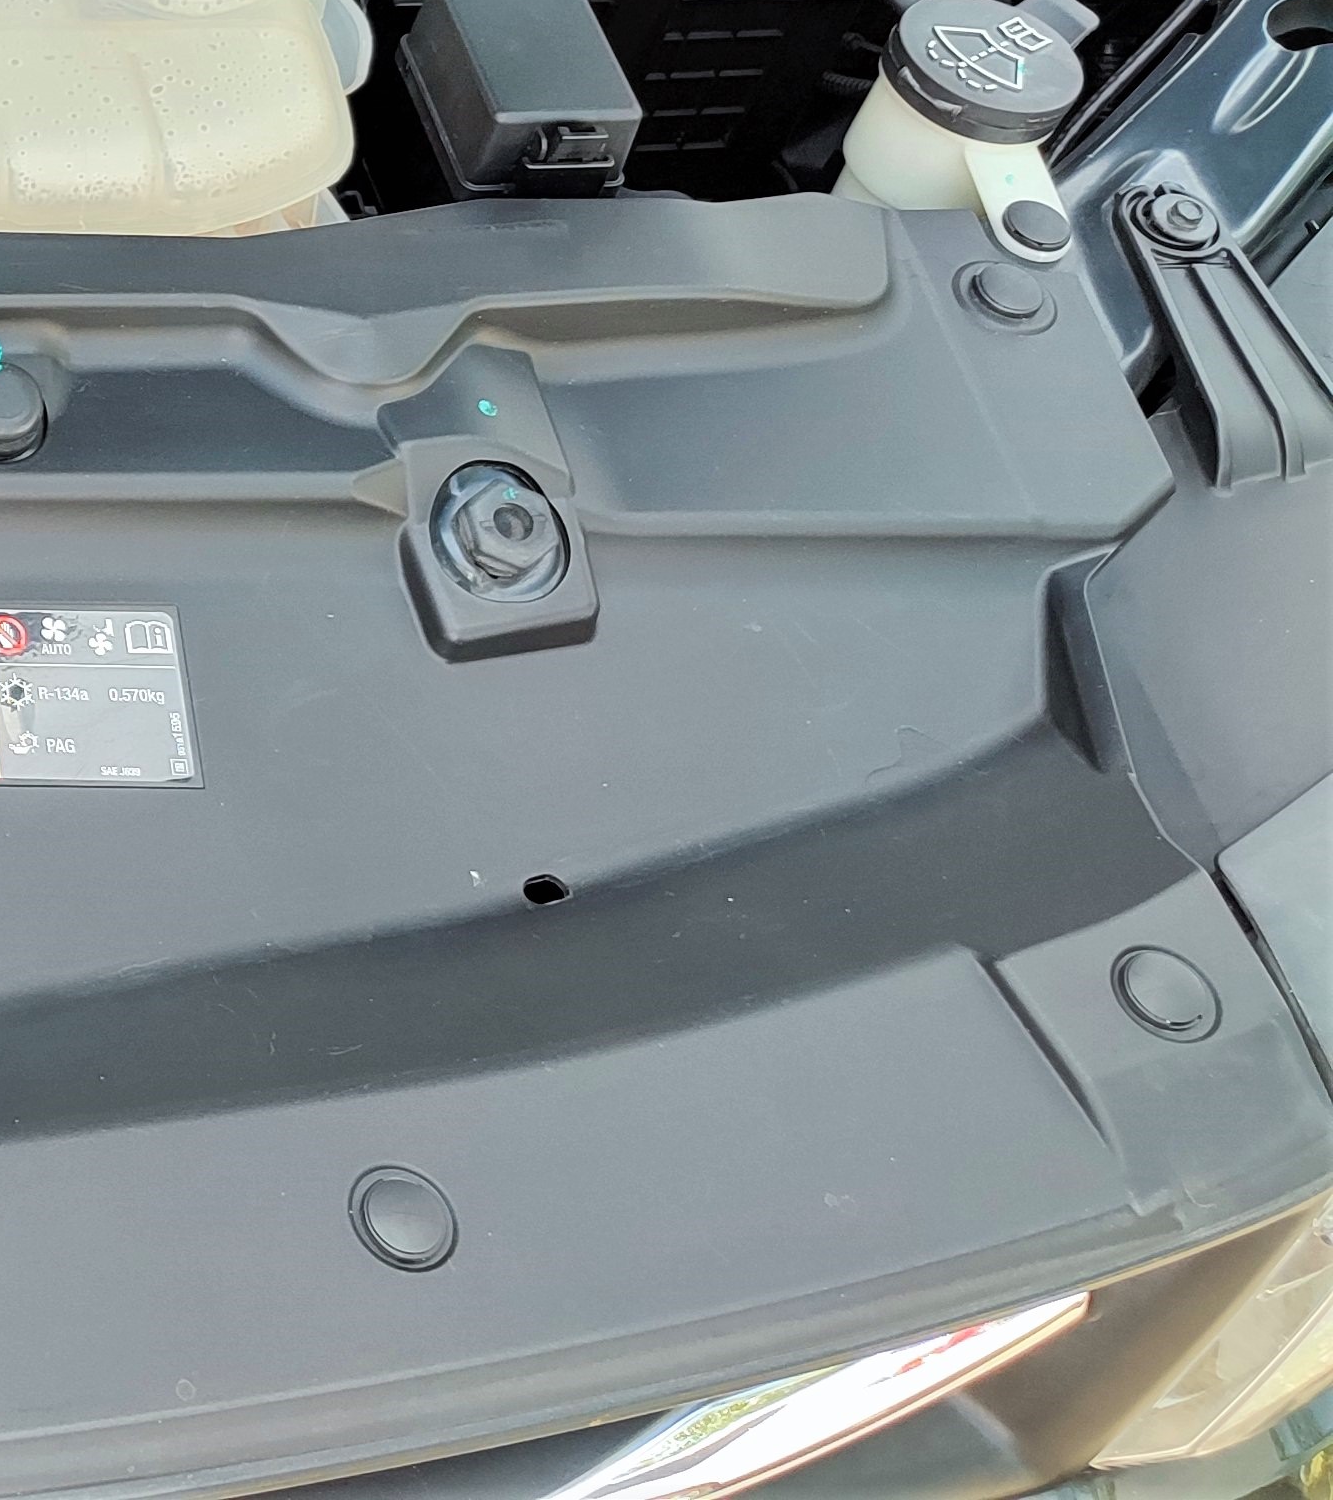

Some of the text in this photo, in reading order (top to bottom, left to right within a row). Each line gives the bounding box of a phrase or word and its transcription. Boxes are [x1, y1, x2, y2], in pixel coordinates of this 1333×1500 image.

[40, 643, 72, 656] AUTO
[38, 686, 165, 705] R-134a 0.570kg
[46, 738, 76, 754] PAG
